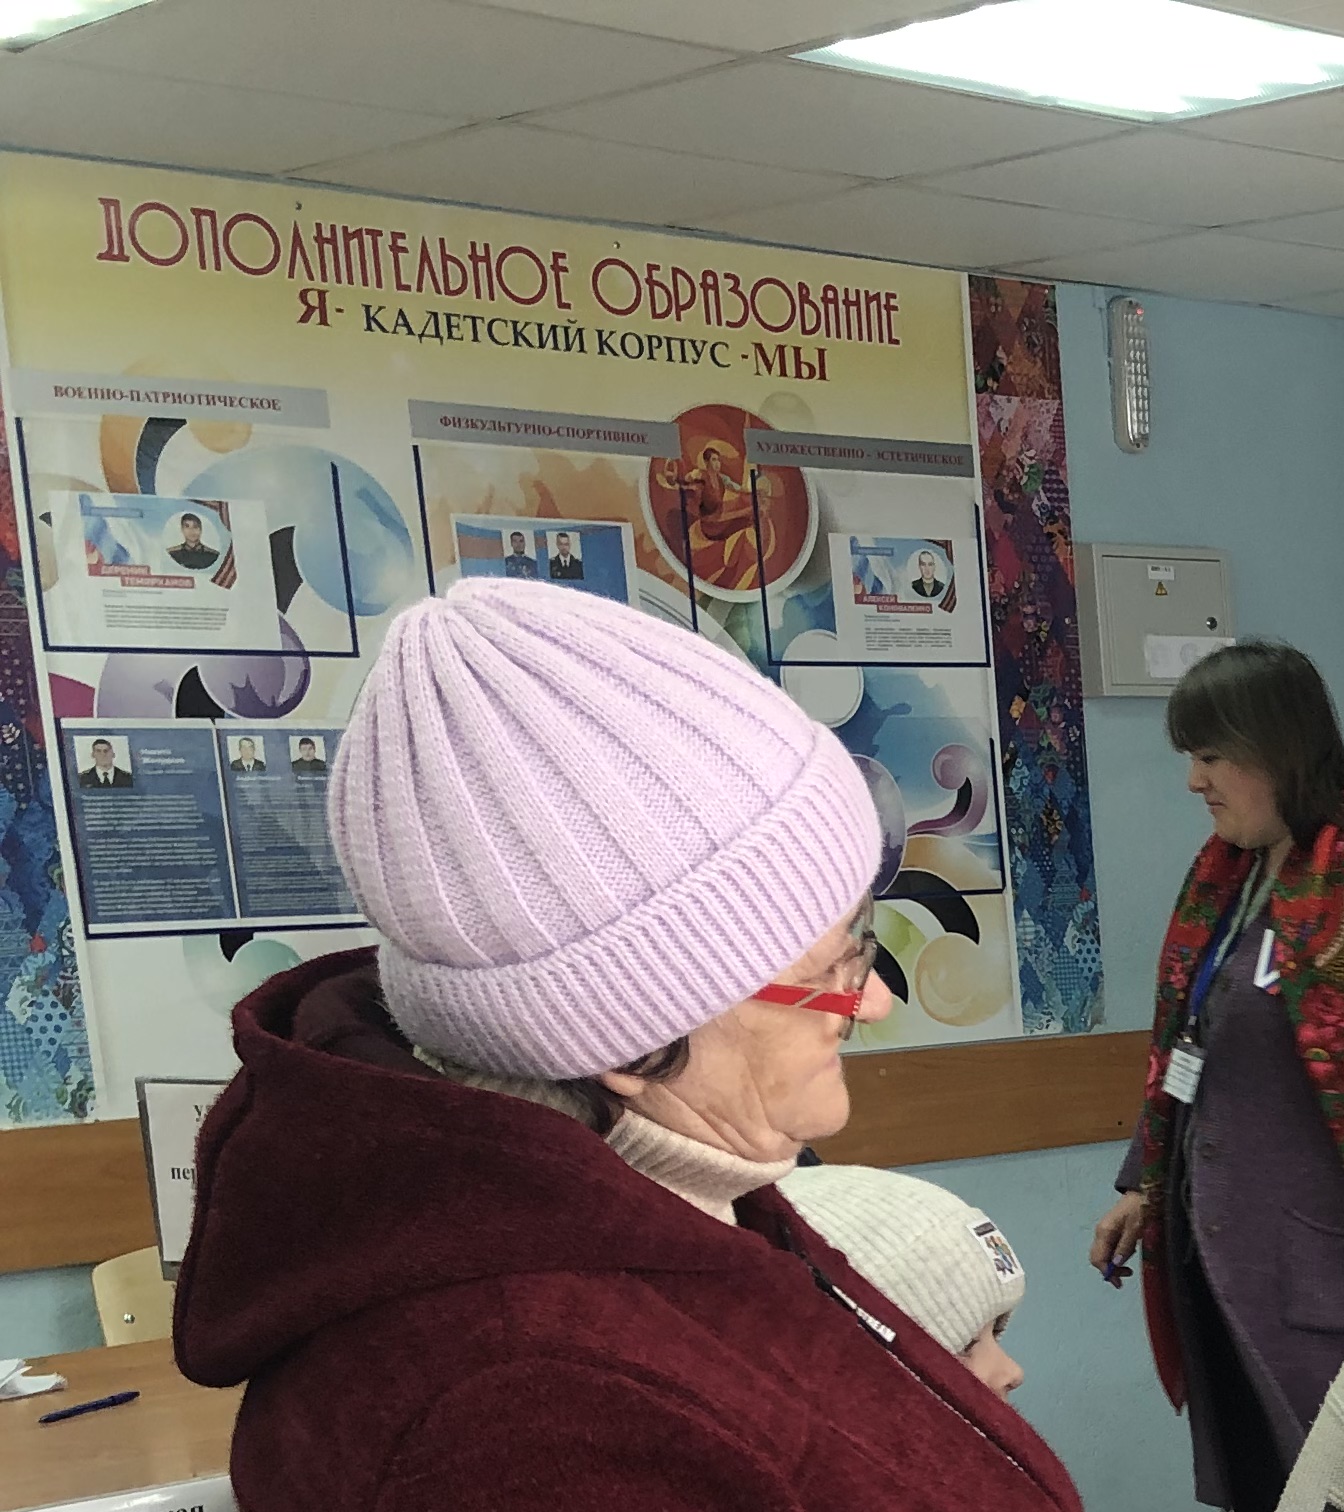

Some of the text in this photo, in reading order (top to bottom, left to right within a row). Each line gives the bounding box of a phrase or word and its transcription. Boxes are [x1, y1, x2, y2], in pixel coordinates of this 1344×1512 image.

[96, 197, 901, 346] ДОПОЛНИТЕЛЬНОЕ ОБРАЗОВАНИЕ
[361, 302, 587, 355] КАДЕТСКИЙ
[595, 328, 731, 368] КОРПУС
[53, 384, 283, 411] ВОЕННО-ПАТРИОТИЧЕСКОЕ
[440, 415, 650, 445] ФИЗКУЛЬТУРНО-СПОРТИВНОЕ
